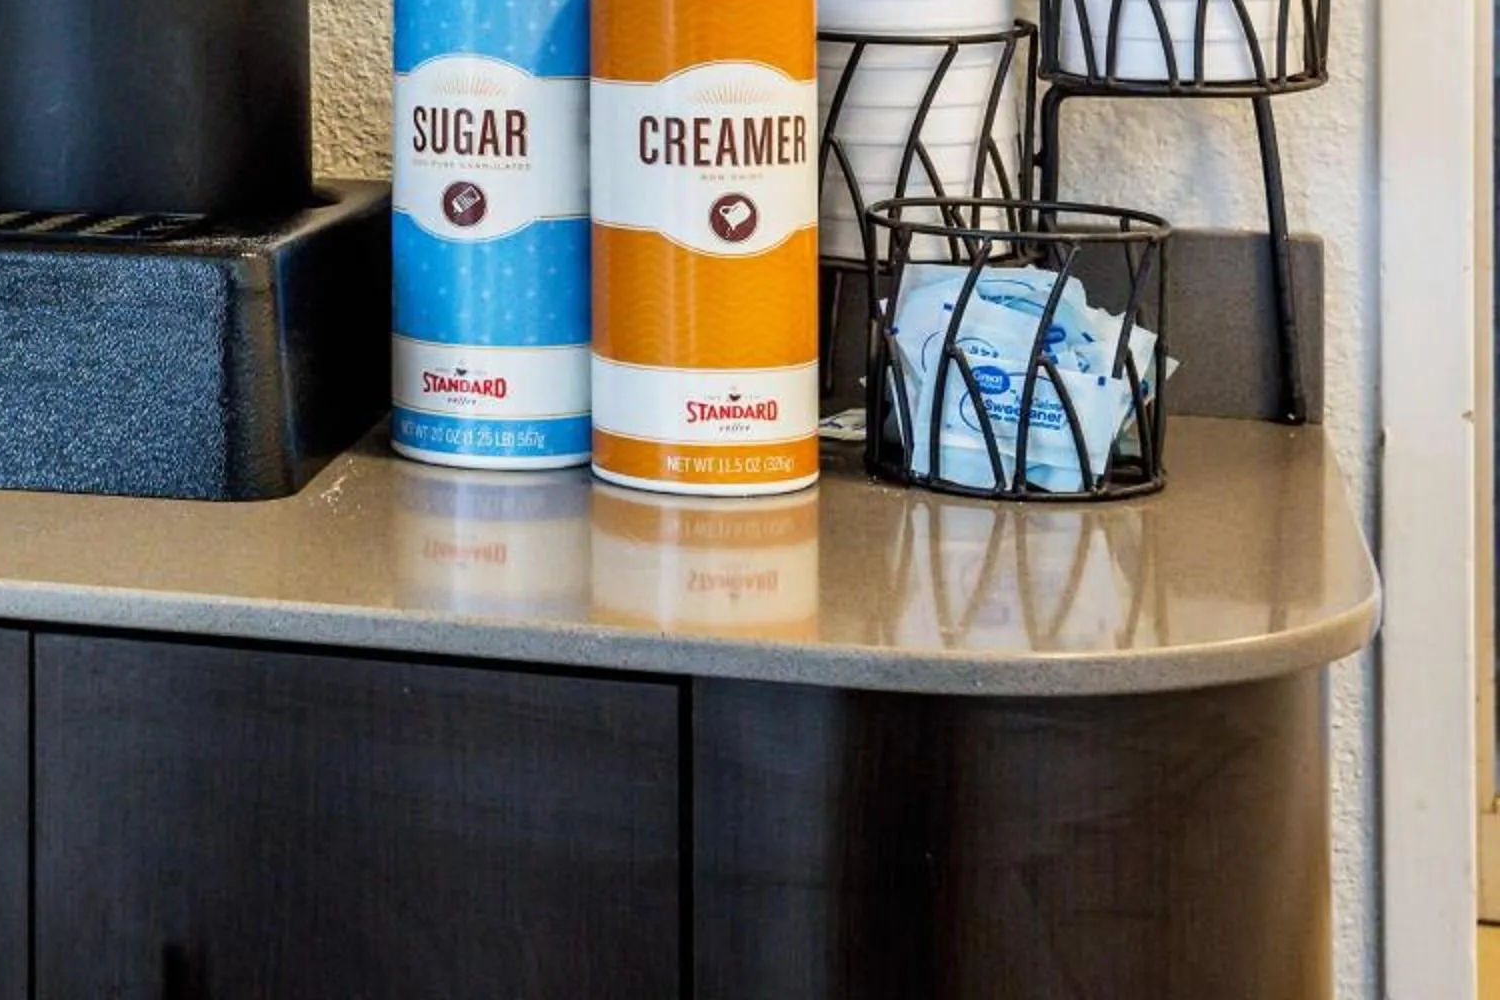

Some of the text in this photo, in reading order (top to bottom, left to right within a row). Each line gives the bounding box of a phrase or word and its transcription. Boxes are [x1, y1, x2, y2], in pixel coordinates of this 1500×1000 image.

[412, 105, 528, 158] SUGAR
[638, 115, 807, 167] CREAMER
[423, 371, 507, 399] STANDARD
[686, 400, 778, 423] STANDARD
[445, 428, 461, 445] OZ
[666, 456, 690, 473] NET
[692, 456, 714, 473] WT
[745, 456, 762, 473] OZ
